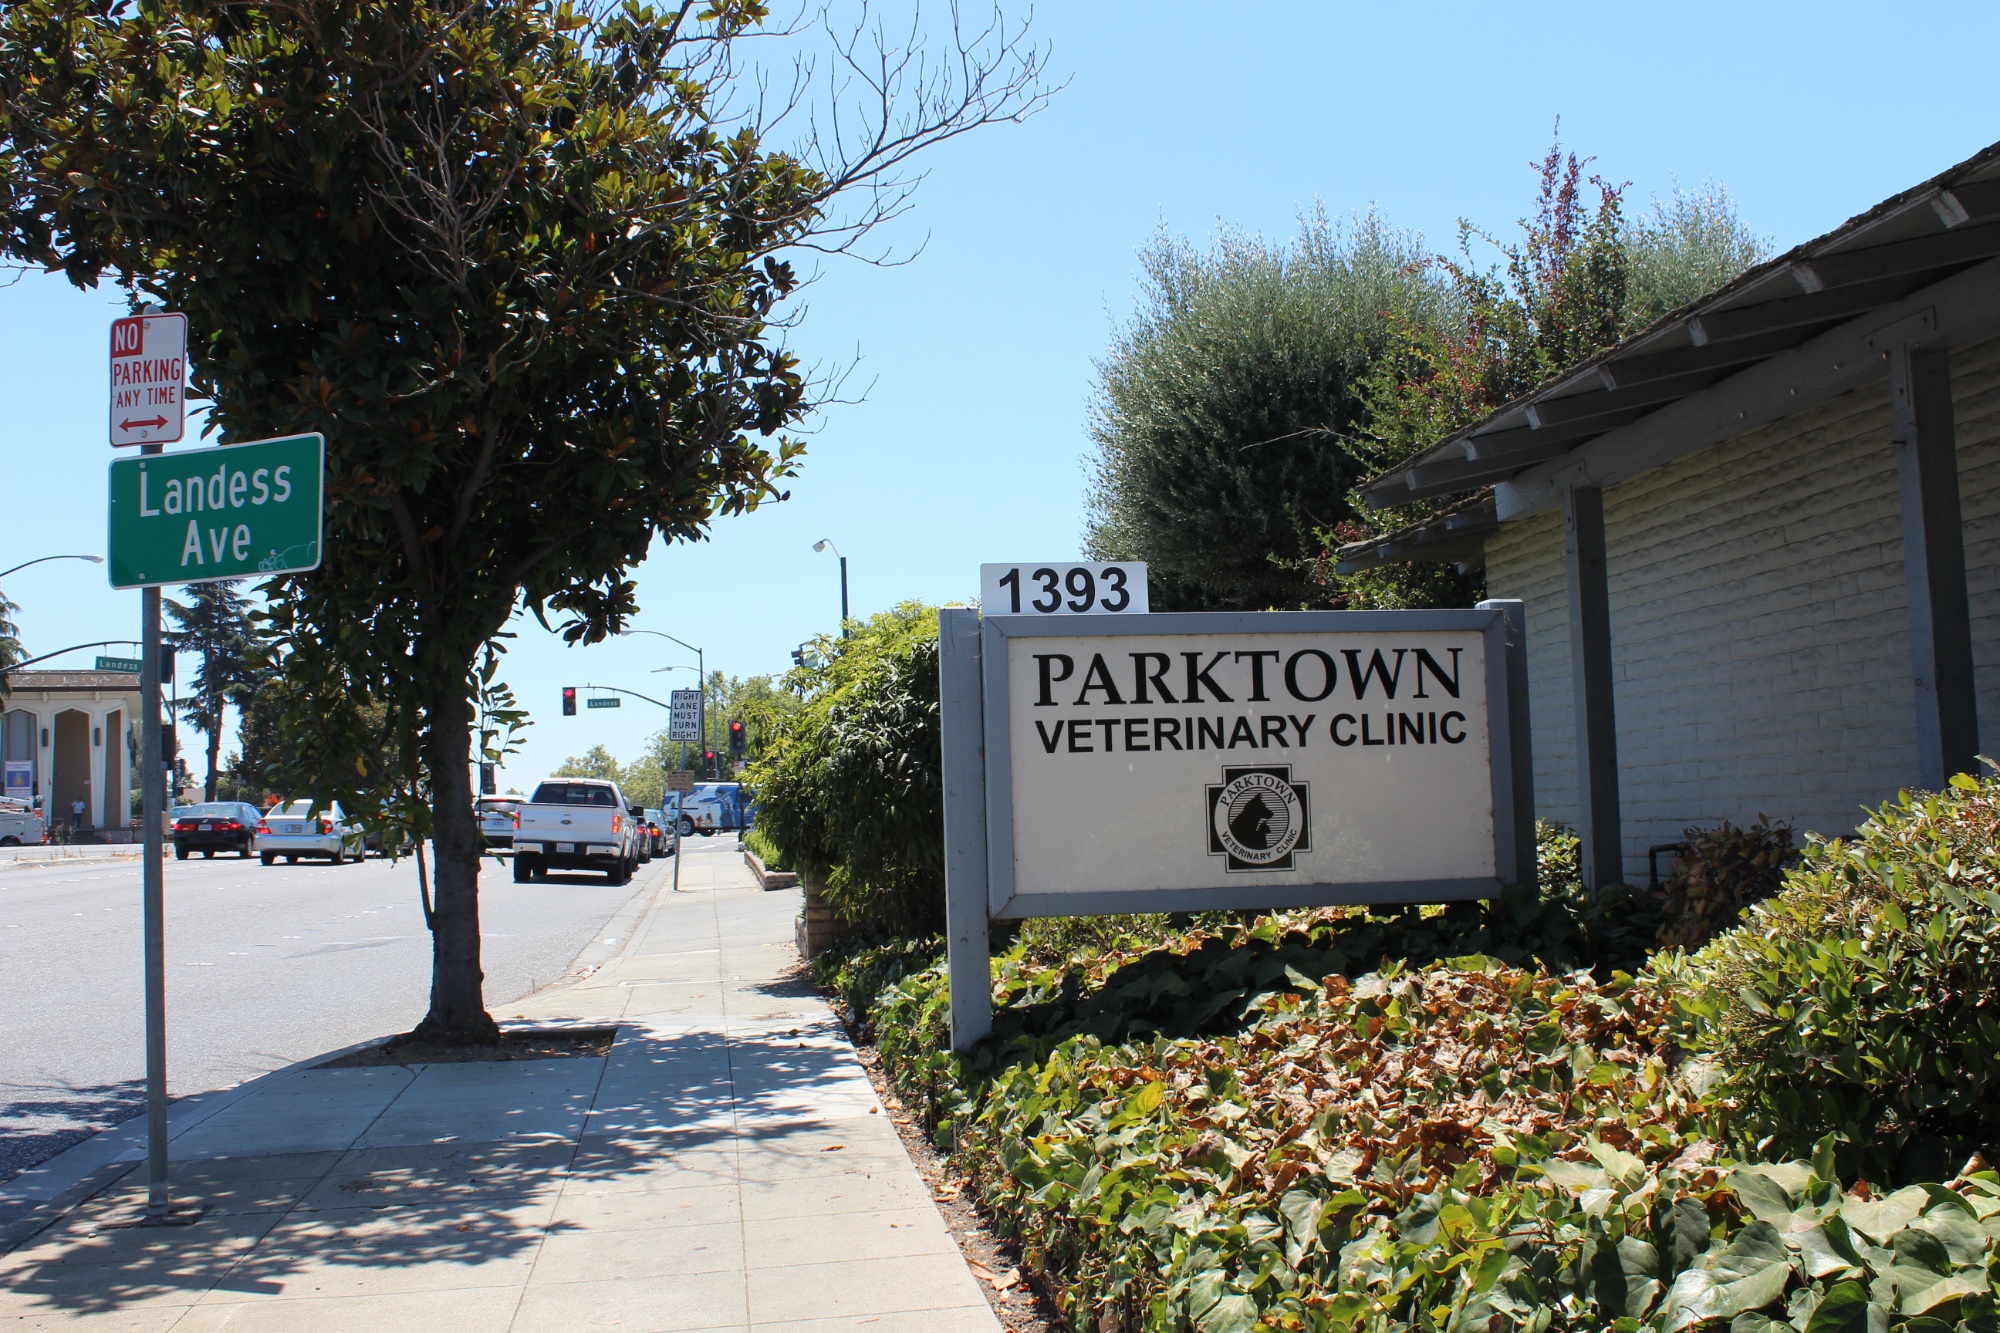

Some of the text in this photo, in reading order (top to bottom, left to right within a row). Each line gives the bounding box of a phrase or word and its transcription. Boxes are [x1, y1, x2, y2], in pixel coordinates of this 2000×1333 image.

[115, 323, 139, 352] NO
[114, 358, 181, 386] PARKING
[116, 386, 175, 409] ANY TIME
[140, 464, 292, 517] Landess
[181, 520, 251, 567] Ave
[998, 566, 1131, 614] 1393
[99, 659, 139, 670] Landess
[1032, 647, 1464, 707] PARKTOWN
[674, 702, 698, 710] LANE
[672, 731, 697, 739] RIGHT
[673, 721, 697, 729] TURN
[1035, 710, 1467, 754] VETERINARY CLINIC
[1220, 775, 1297, 806] PARKTOWN
[1221, 829, 1298, 860] VETERINARY CLINIC
